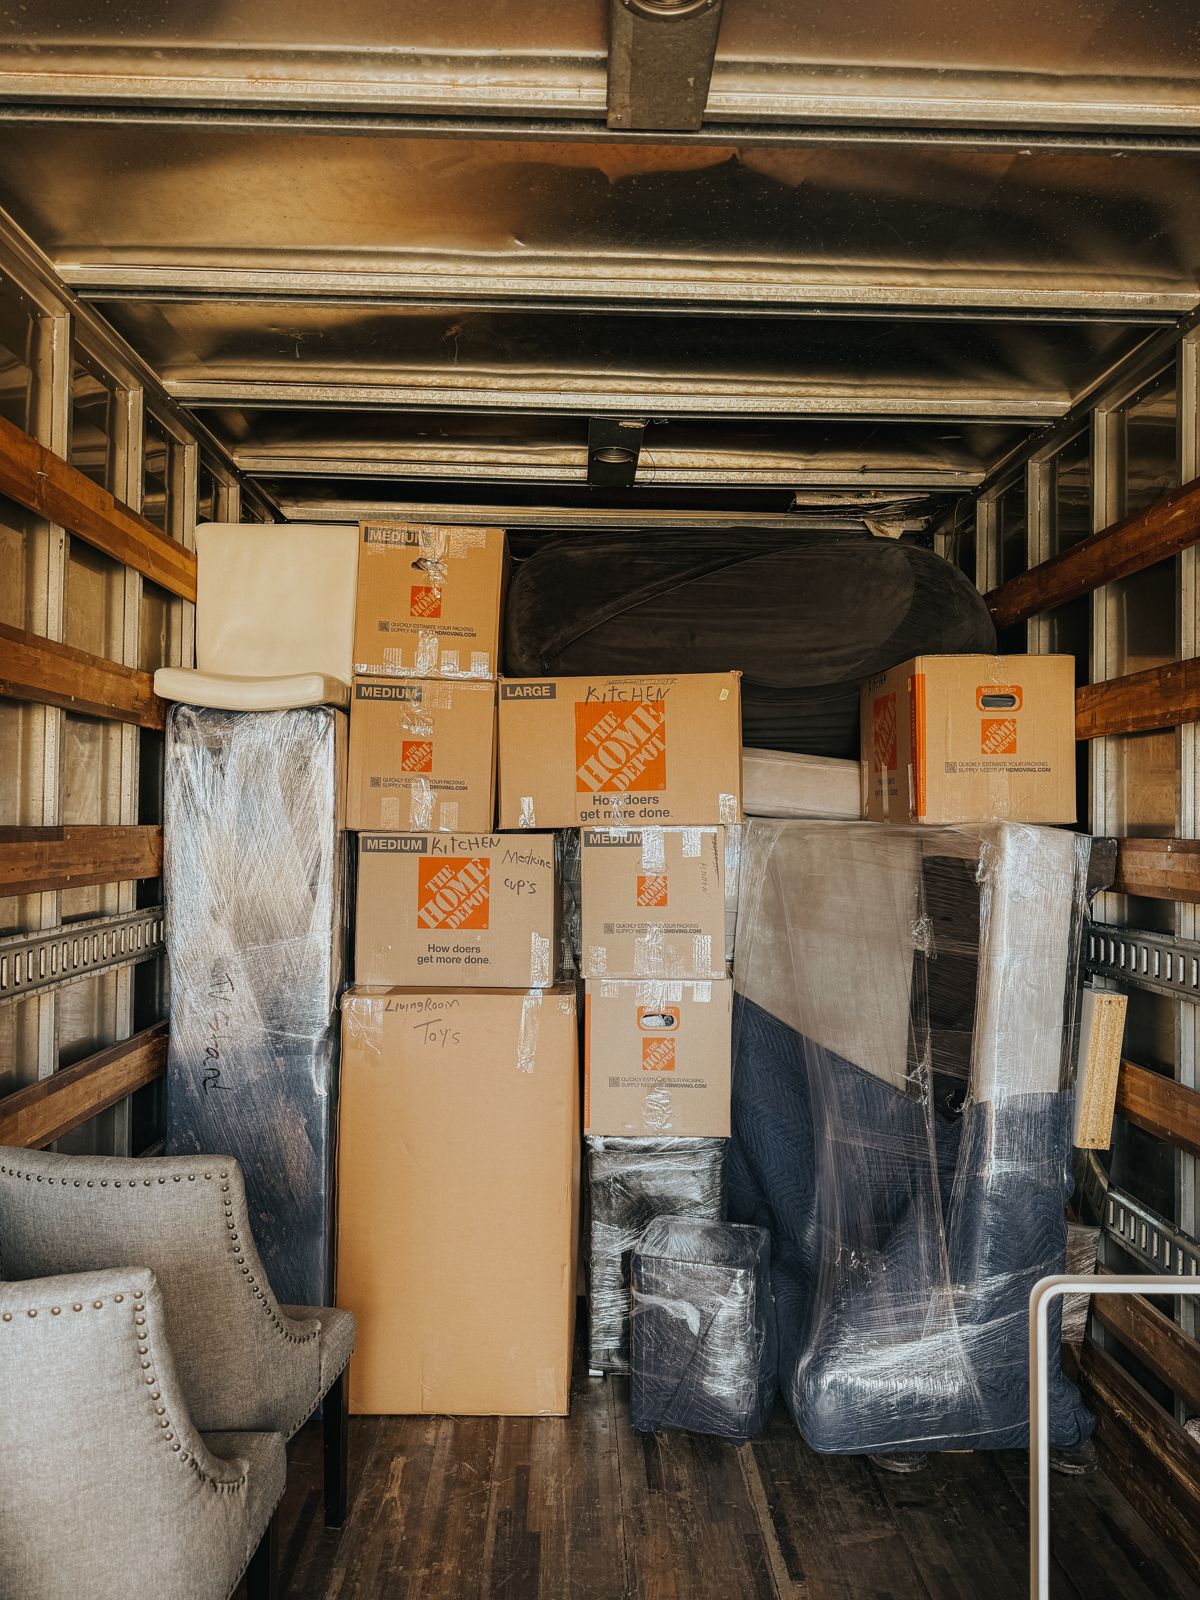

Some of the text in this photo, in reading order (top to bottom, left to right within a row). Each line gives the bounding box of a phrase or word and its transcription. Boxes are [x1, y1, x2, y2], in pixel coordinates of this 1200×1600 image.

[506, 686, 551, 698] LARGE
[584, 710, 623, 747] THE
[982, 719, 1016, 754] HOME
[986, 721, 1001, 737] THE
[576, 701, 666, 792] HOME
[995, 731, 1016, 754] DEPOT
[611, 733, 666, 791] DEPOT
[623, 794, 660, 805] doers
[580, 808, 601, 822] get
[366, 839, 423, 850] MEDIUM
[425, 864, 456, 893] THE
[418, 858, 490, 929] HOME
[445, 884, 490, 929] DEPOT
[427, 943, 481, 954] How doers
[417, 955, 492, 966] get more done.
